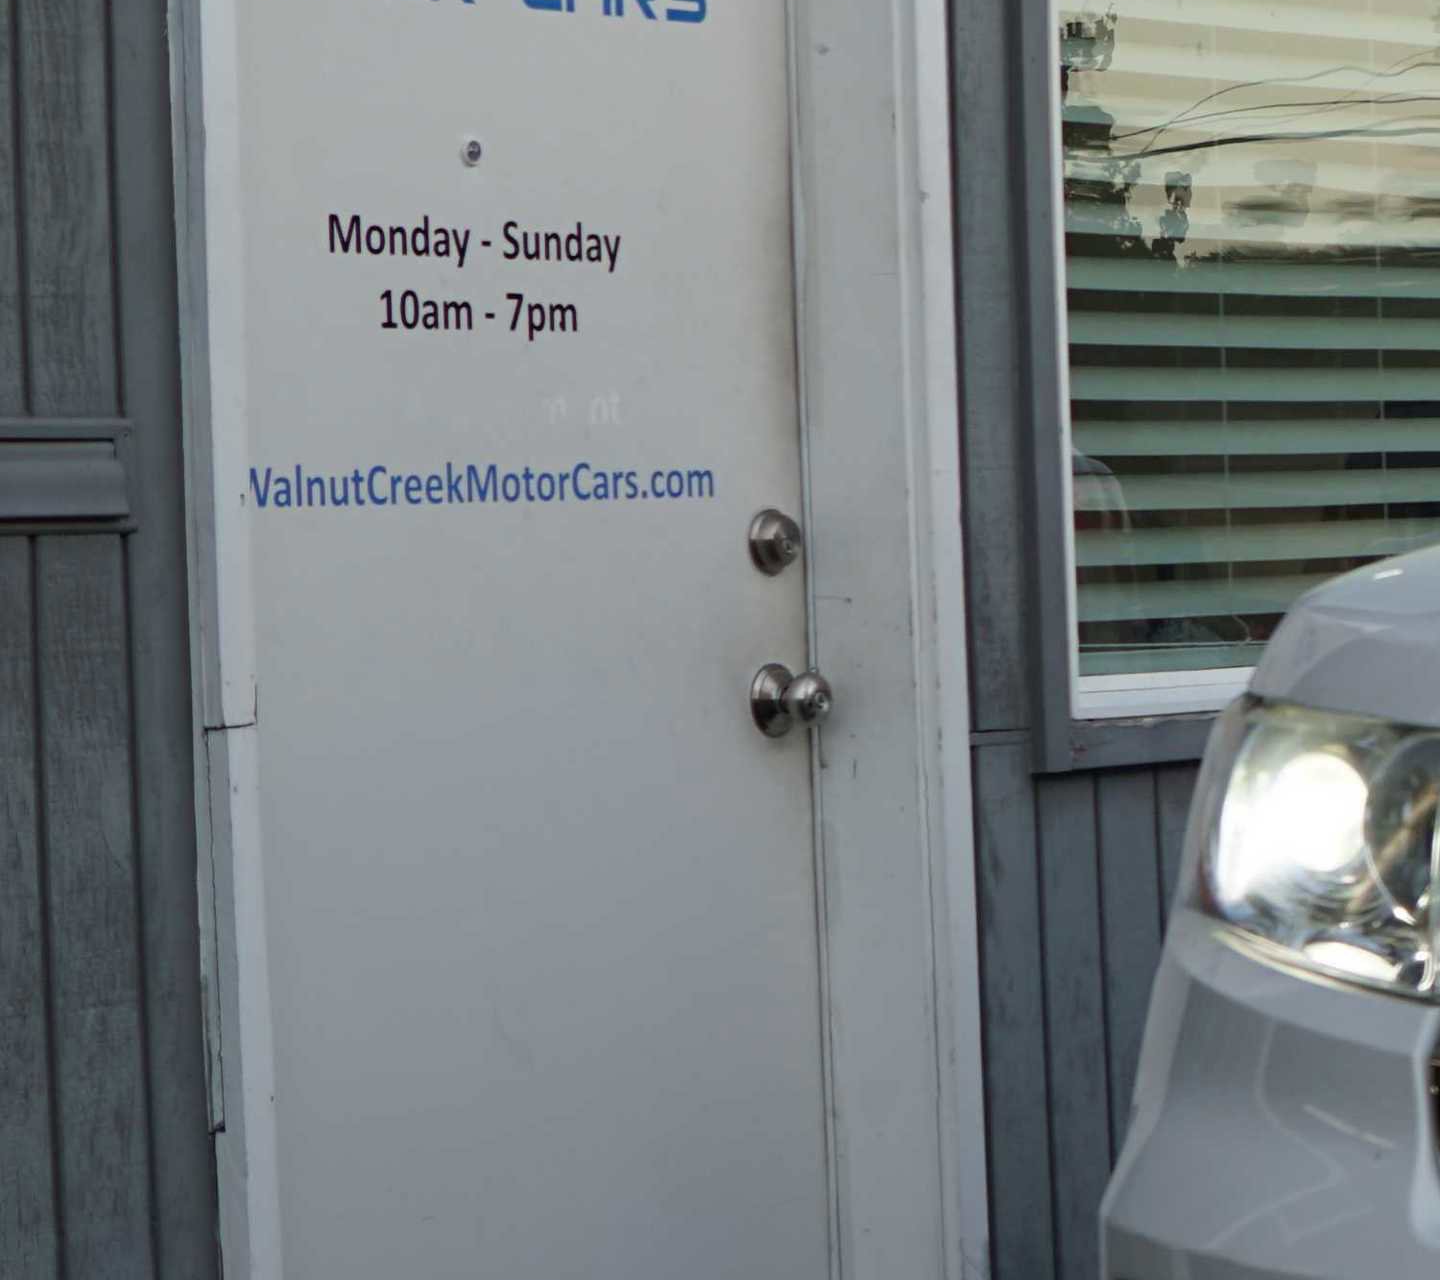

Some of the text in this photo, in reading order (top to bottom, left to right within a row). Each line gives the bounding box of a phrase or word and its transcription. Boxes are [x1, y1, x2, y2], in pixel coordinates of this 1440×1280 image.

[327, 213, 471, 268] Monday
[502, 220, 621, 273] Sunday
[379, 289, 474, 330] 10am
[505, 292, 579, 341] 7pm
